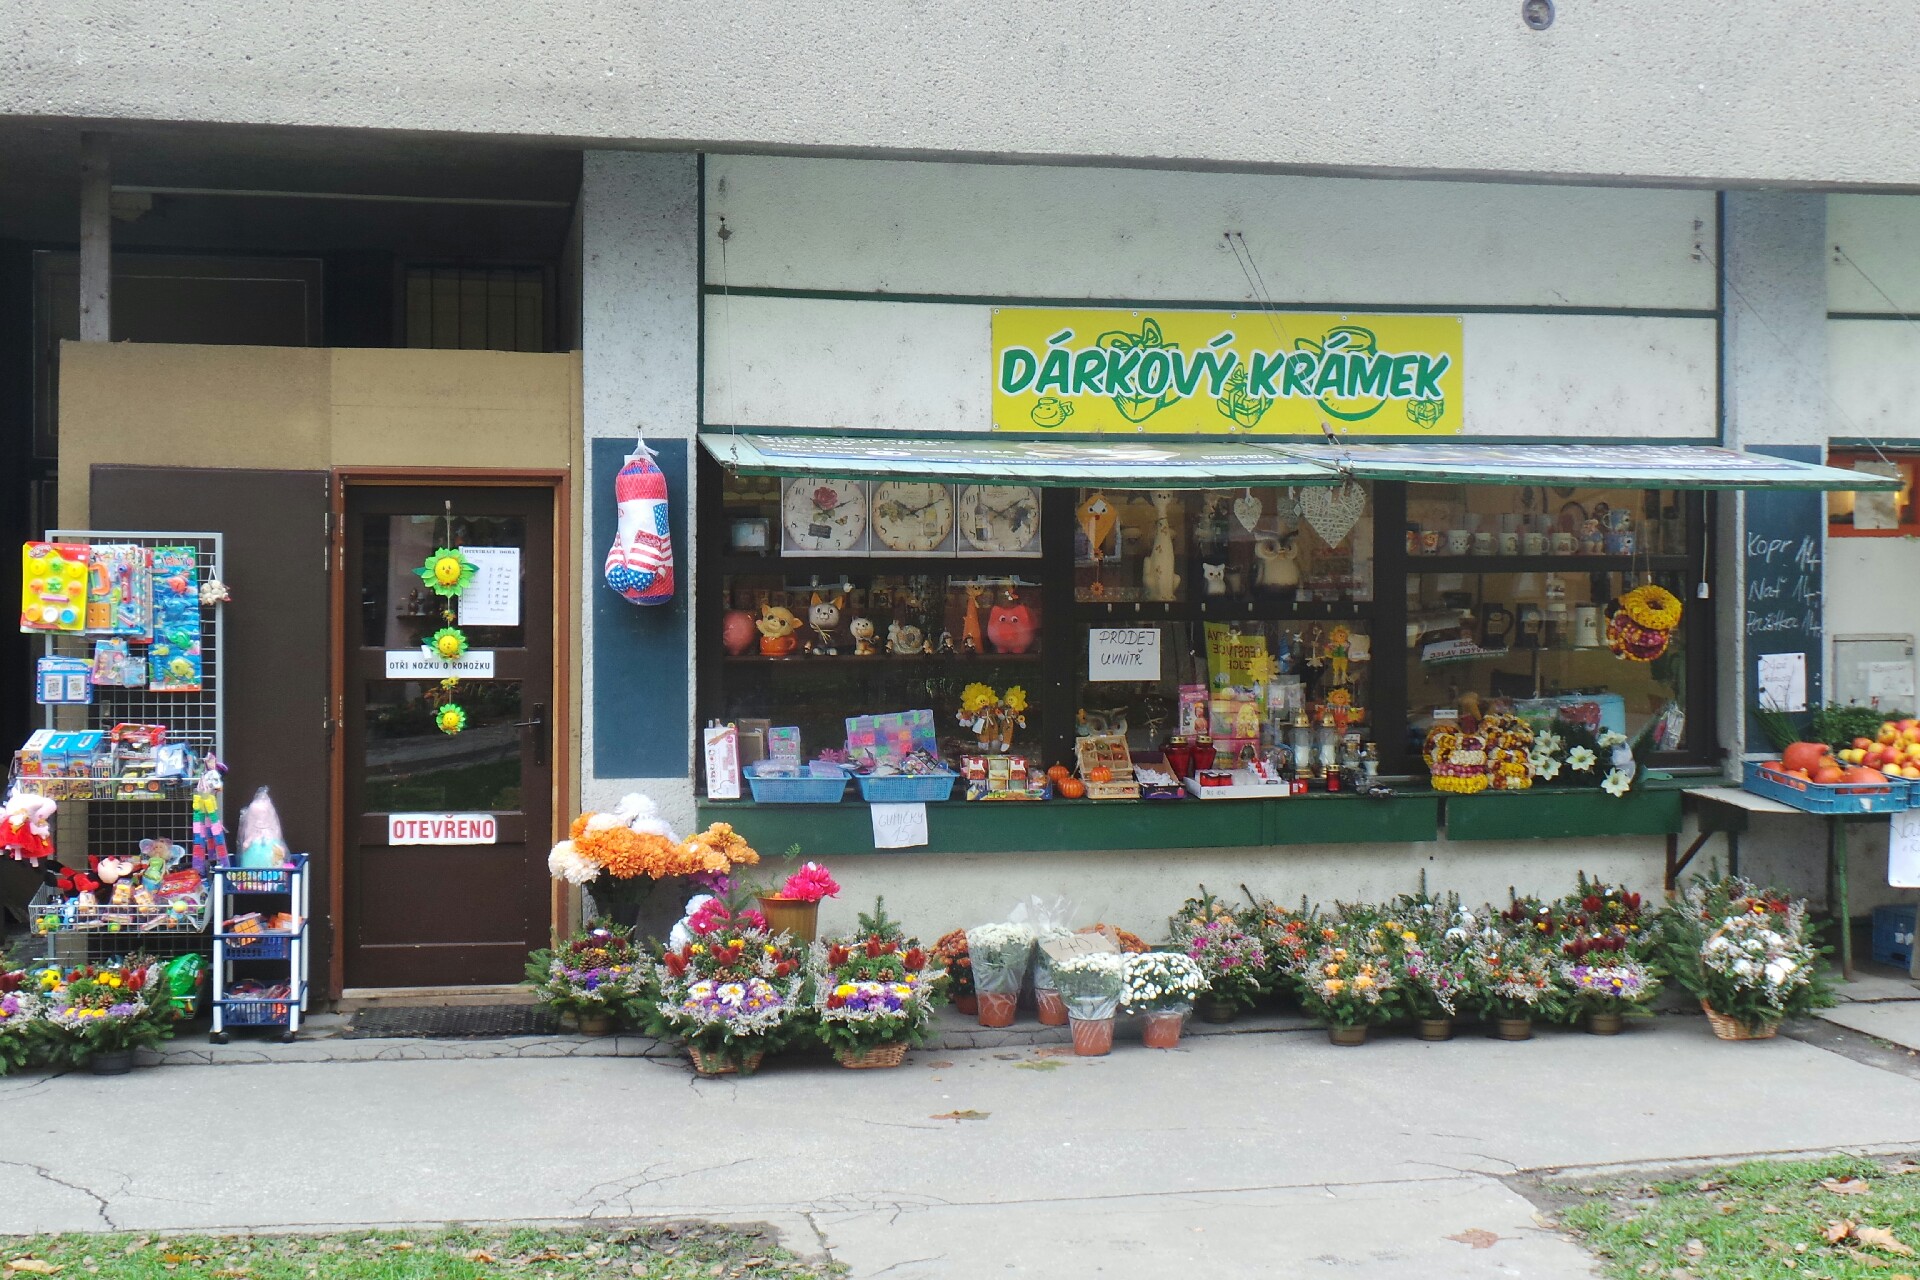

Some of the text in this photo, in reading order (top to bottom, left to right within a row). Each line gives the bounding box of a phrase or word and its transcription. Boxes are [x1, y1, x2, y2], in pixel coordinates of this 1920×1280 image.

[1002, 330, 1448, 397] DÁRKOVÝ KRÁMEK
[1747, 531, 1793, 564] Kopr
[1099, 629, 1155, 646] PRODEJ
[389, 660, 490, 670] OTŘI NOŽKU O ROHOŽKU
[1100, 648, 1143, 666] UVNITŘ
[392, 814, 495, 839] OTEVŘENO
